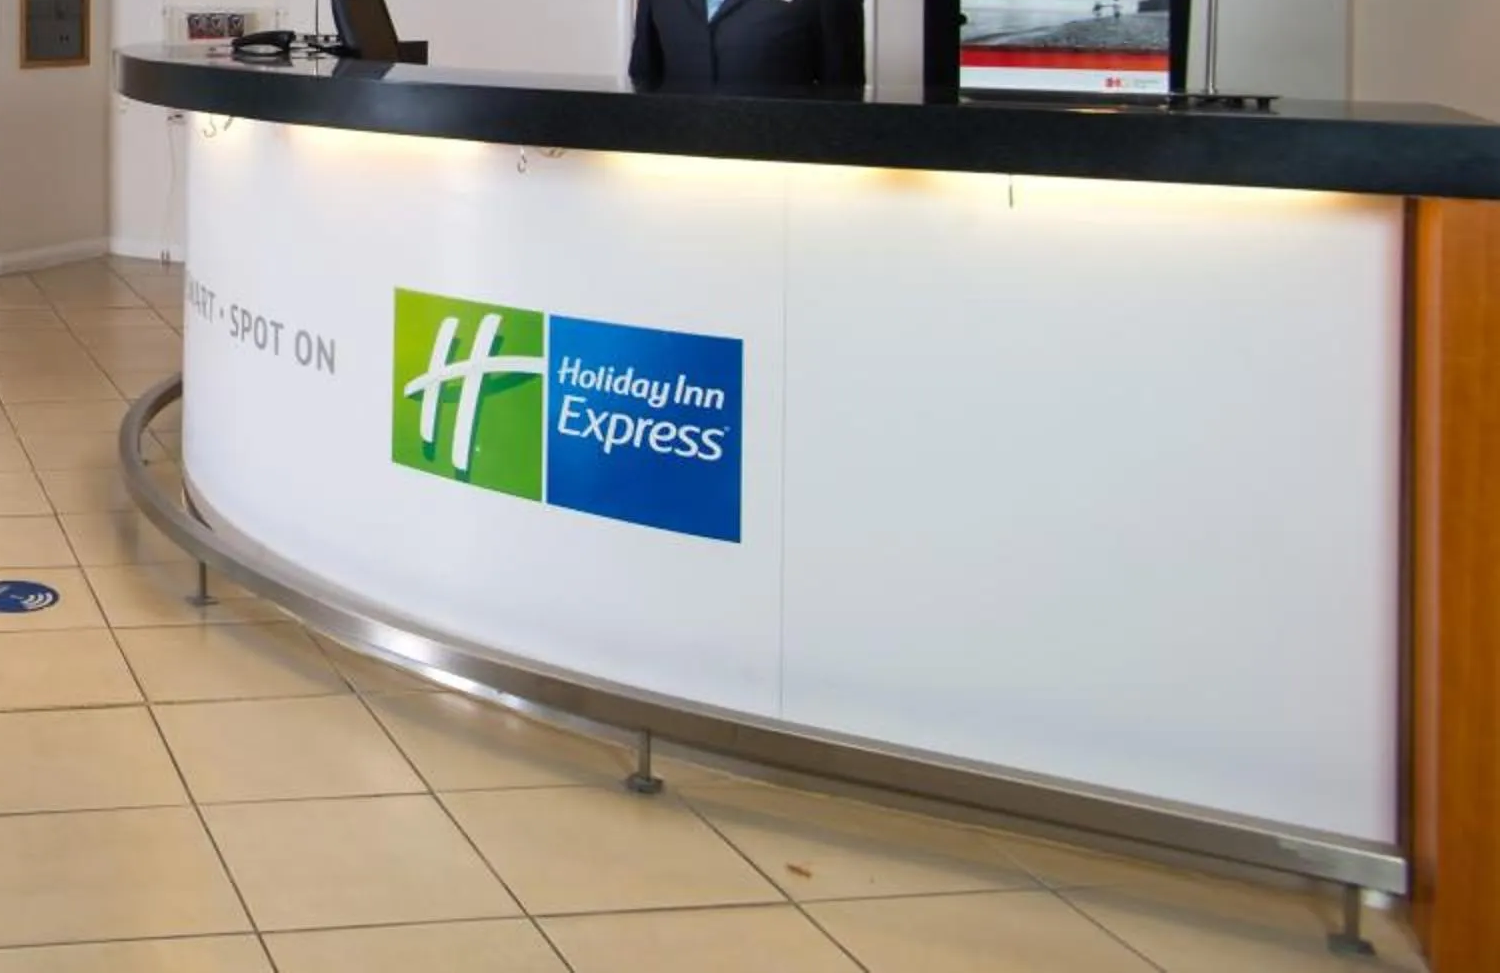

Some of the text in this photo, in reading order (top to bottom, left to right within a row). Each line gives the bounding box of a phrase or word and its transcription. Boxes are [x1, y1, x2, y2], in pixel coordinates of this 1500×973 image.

[229, 303, 285, 356] SPOT
[294, 329, 335, 375] ON
[557, 355, 725, 410] Holiday Inn
[557, 393, 725, 461] Express
